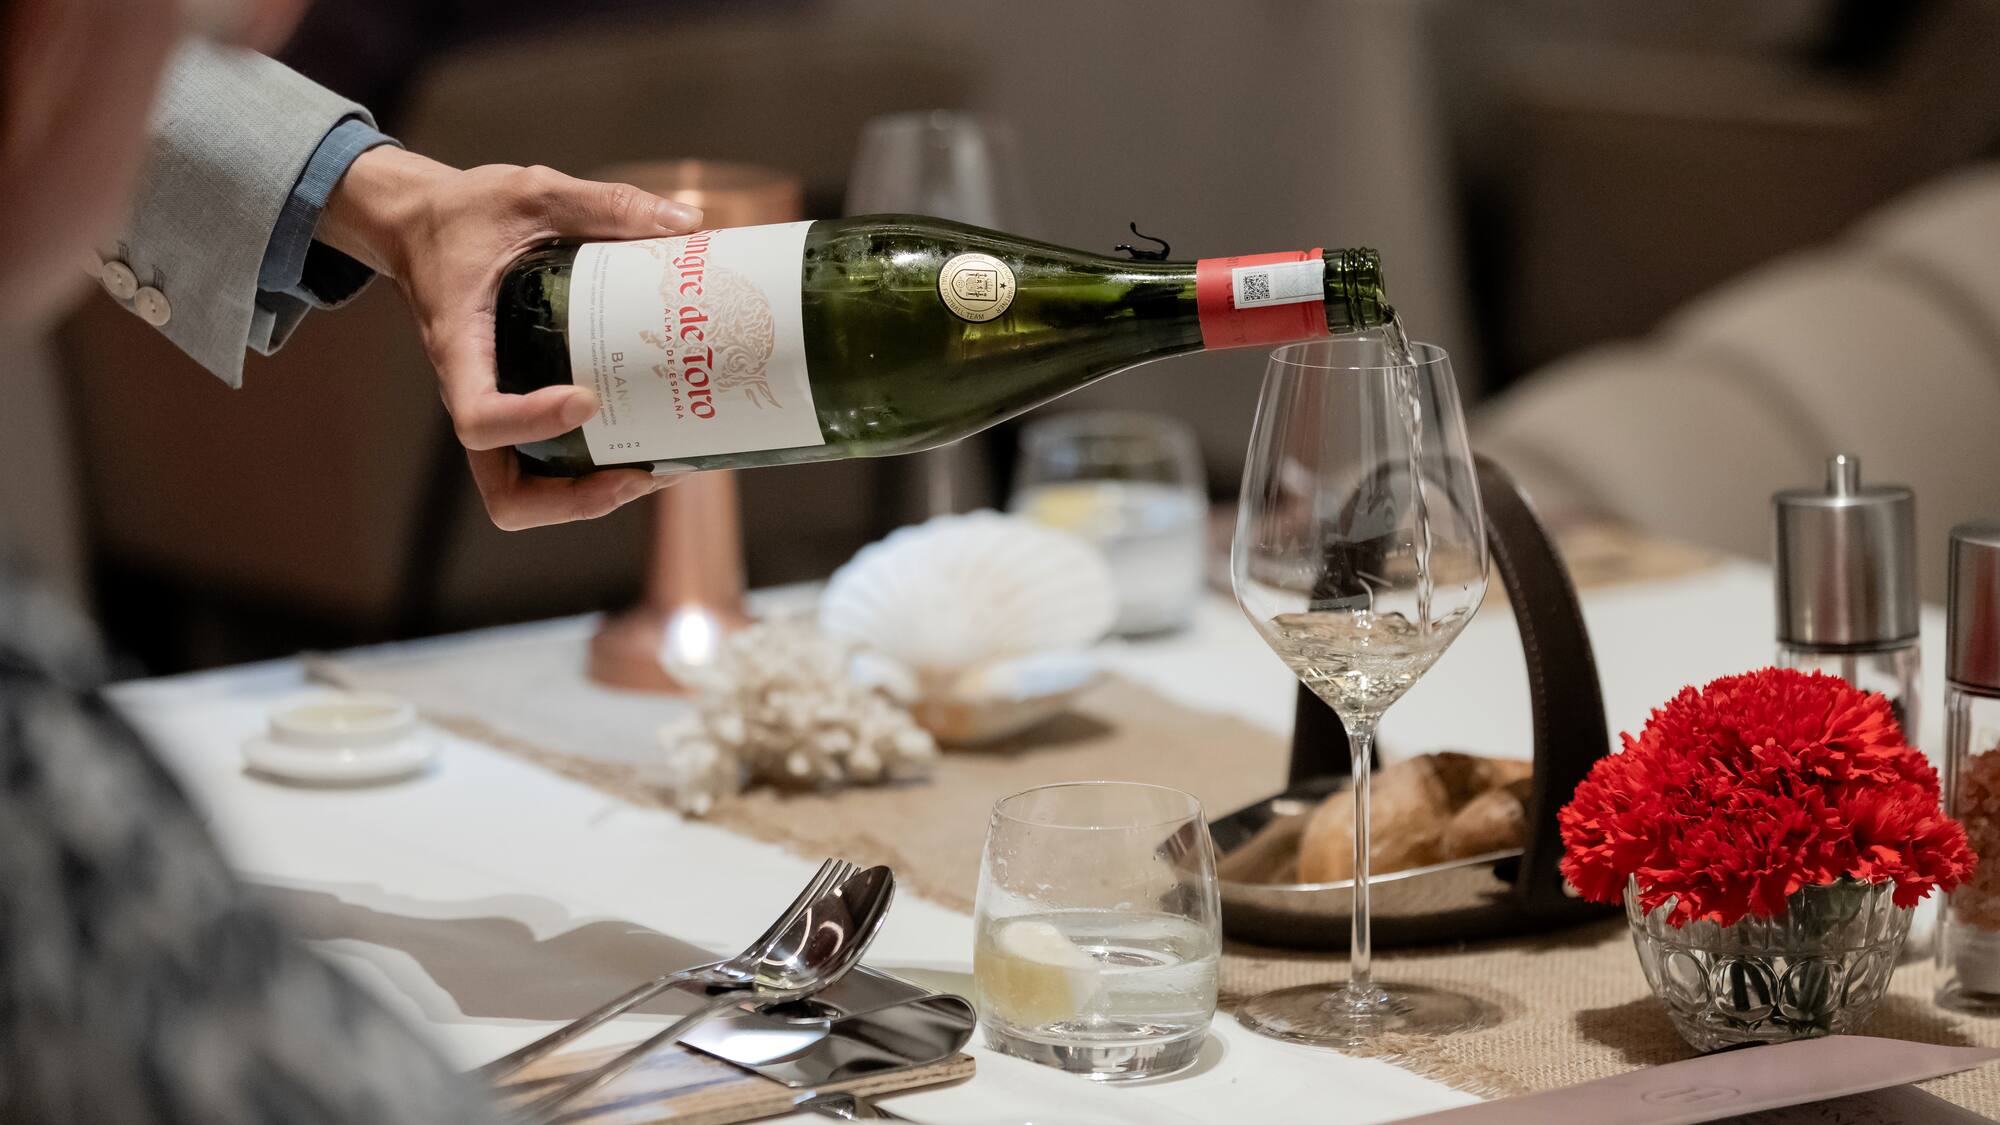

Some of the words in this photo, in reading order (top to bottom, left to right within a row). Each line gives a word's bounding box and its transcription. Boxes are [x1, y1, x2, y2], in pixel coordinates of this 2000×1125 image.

[996, 287, 1014, 314] PARTNER
[664, 308, 673, 342] ALMA
[679, 306, 708, 344] de
[666, 350, 675, 365] DE
[669, 373, 684, 419] ESPAÑA
[682, 345, 716, 419] Toro
[609, 442, 641, 450] 2022
